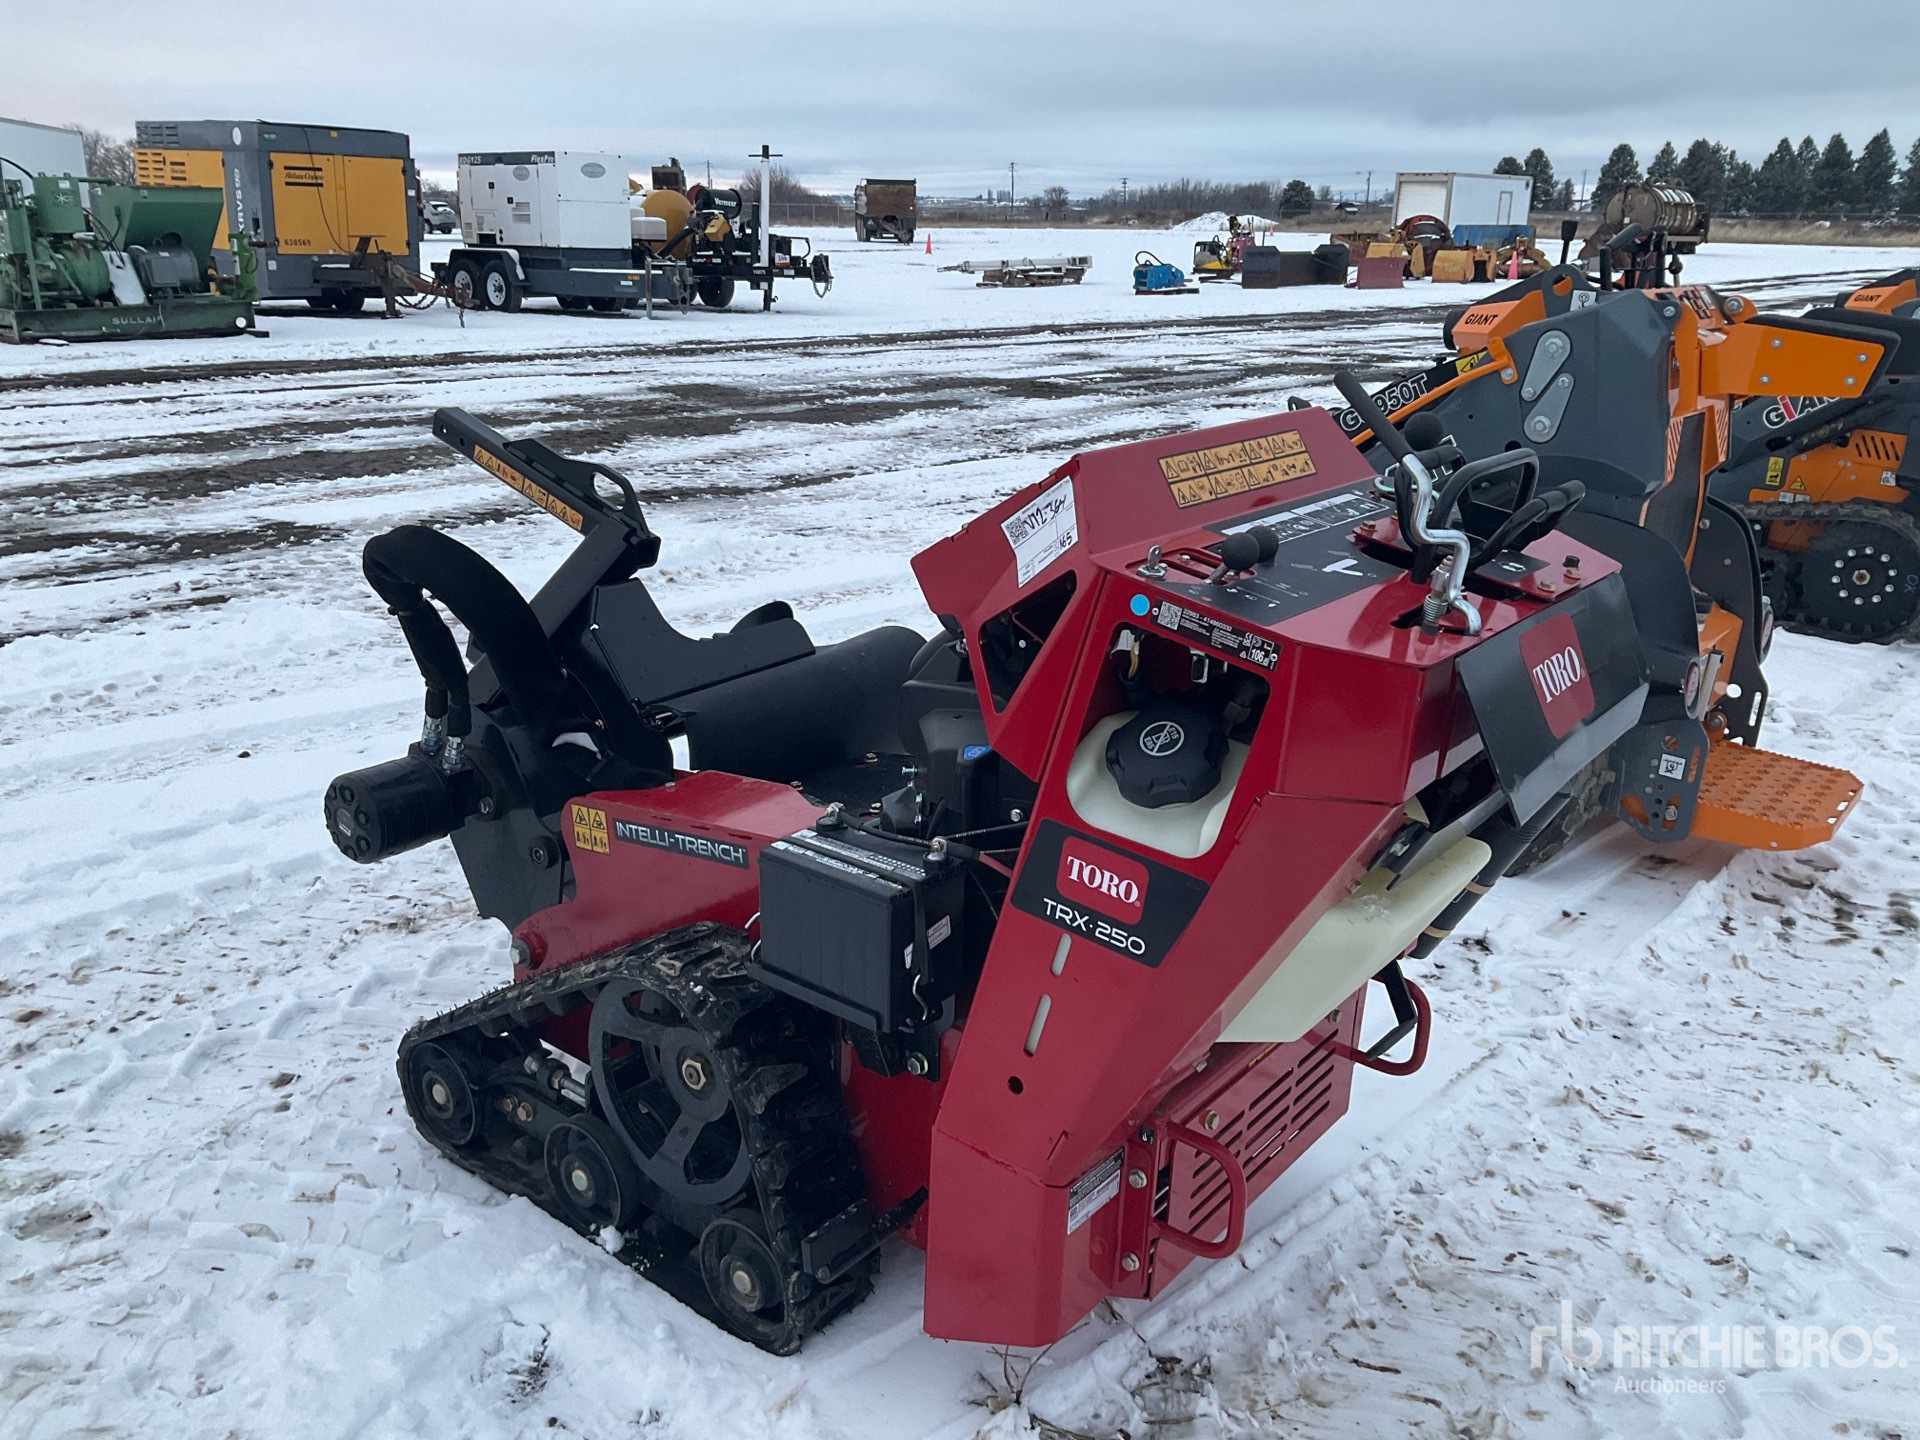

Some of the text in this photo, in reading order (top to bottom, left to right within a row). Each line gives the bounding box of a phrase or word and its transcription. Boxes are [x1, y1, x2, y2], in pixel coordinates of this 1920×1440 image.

[531, 154, 554, 164] FlexPro
[714, 197, 737, 208] Vermeer
[1854, 294, 1882, 303] GIANT
[1465, 313, 1499, 326] GIANT
[1251, 648, 1266, 663] 106
[1532, 646, 1581, 704] TORO
[1066, 855, 1139, 904] TORO
